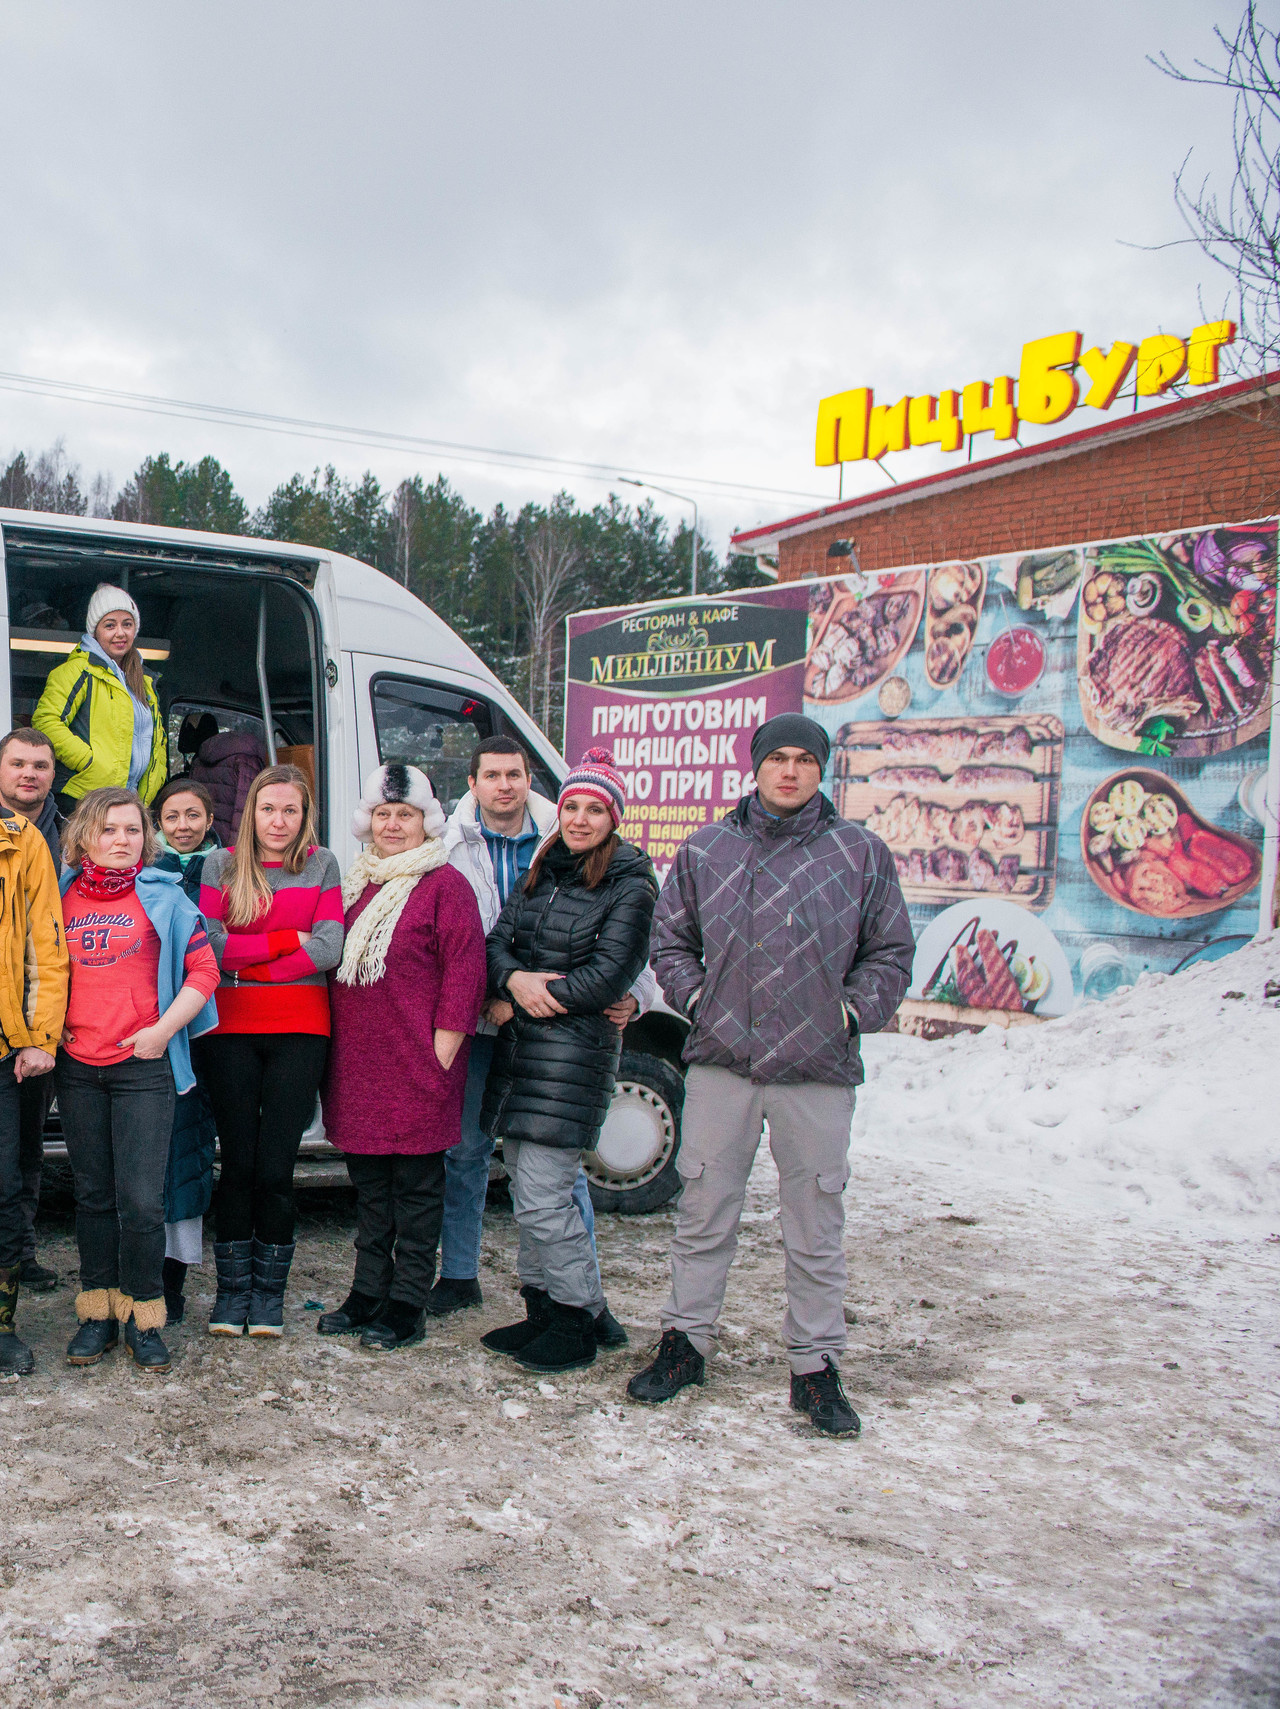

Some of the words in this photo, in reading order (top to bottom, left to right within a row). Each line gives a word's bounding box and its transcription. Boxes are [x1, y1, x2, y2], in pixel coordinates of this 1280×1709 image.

[621, 612, 685, 634] РЕСТОРАН
[688, 610, 699, 626] &
[702, 606, 740, 625] КАФЕ
[592, 696, 767, 737] ПРИГОТОВИМ
[613, 734, 738, 769] ШАШЛЫК
[618, 770, 653, 800] МО
[660, 770, 714, 802] ПРИ
[721, 770, 758, 800] ВА
[622, 804, 707, 822] ИНОВАННОЕ
[649, 823, 699, 840] ШАШЛ
[64, 912, 135, 934] Authentic
[81, 928, 112, 951] 67
